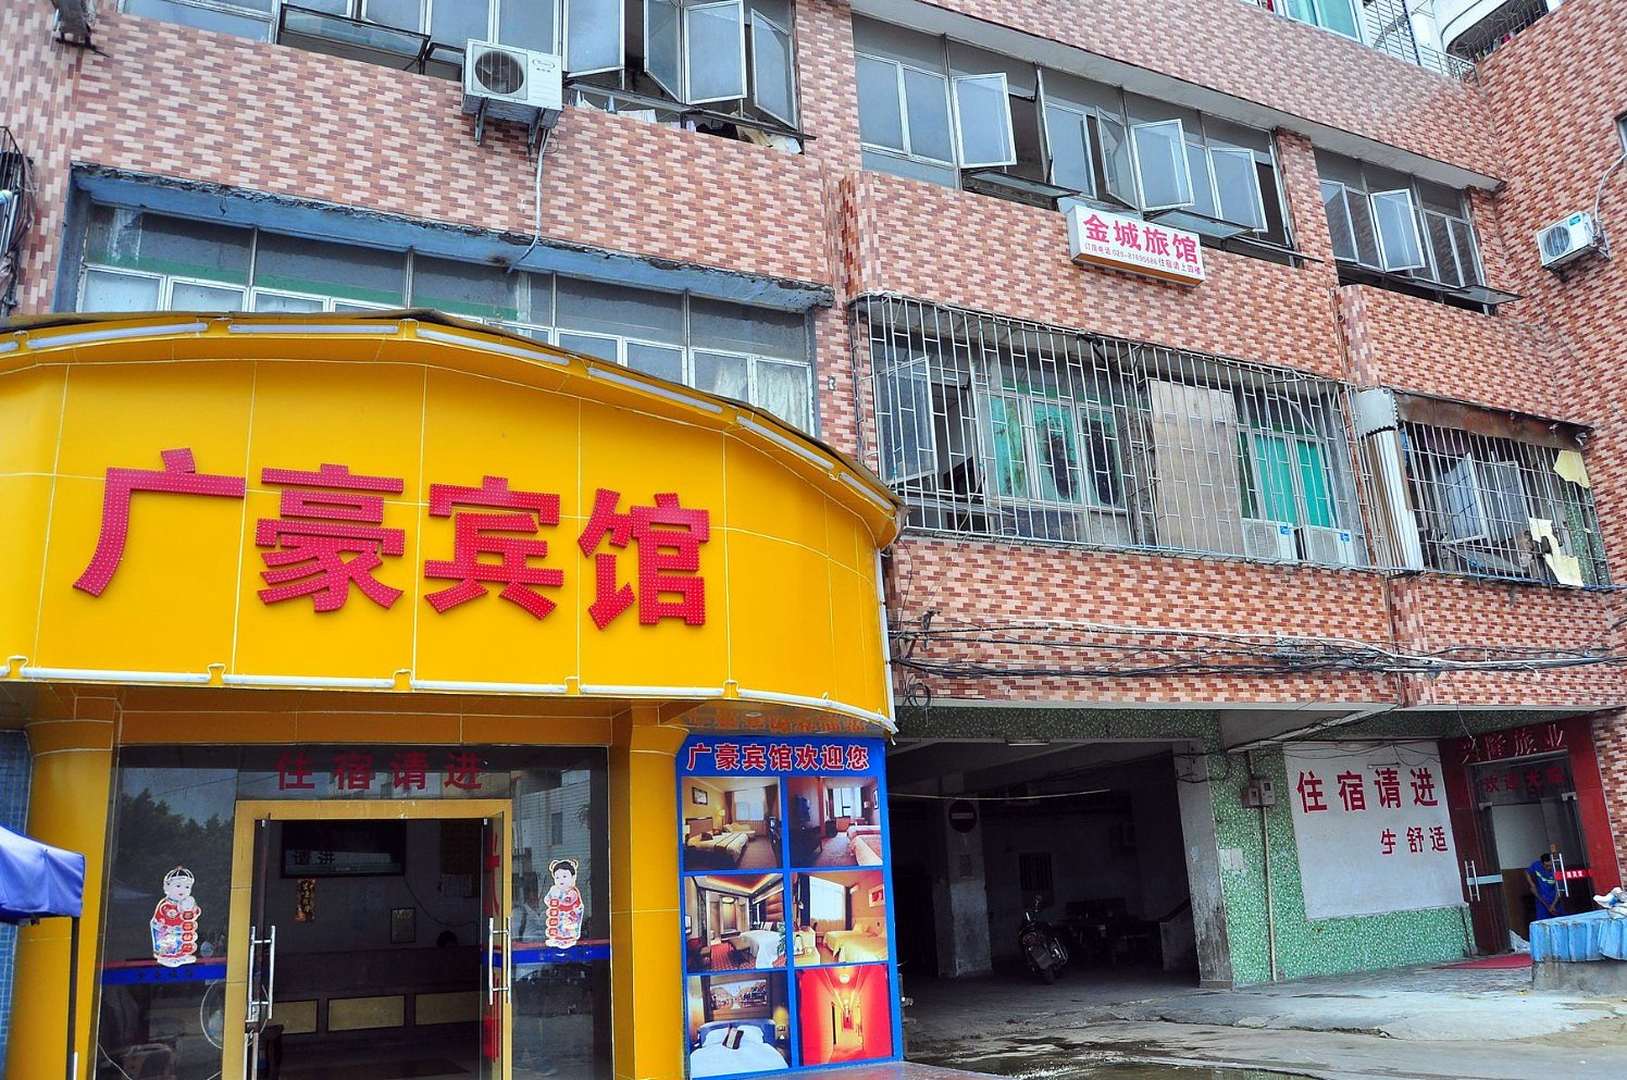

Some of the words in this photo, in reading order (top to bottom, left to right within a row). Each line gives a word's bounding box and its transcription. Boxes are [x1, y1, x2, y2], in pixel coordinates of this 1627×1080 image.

[1083, 214, 1198, 264] 金城旅馆
[73, 448, 709, 629] 广豪宾馆
[275, 751, 483, 791] 住宿请进
[687, 743, 870, 772] 广豪宾馆欢迎您
[1296, 767, 1439, 813] 住宿请进
